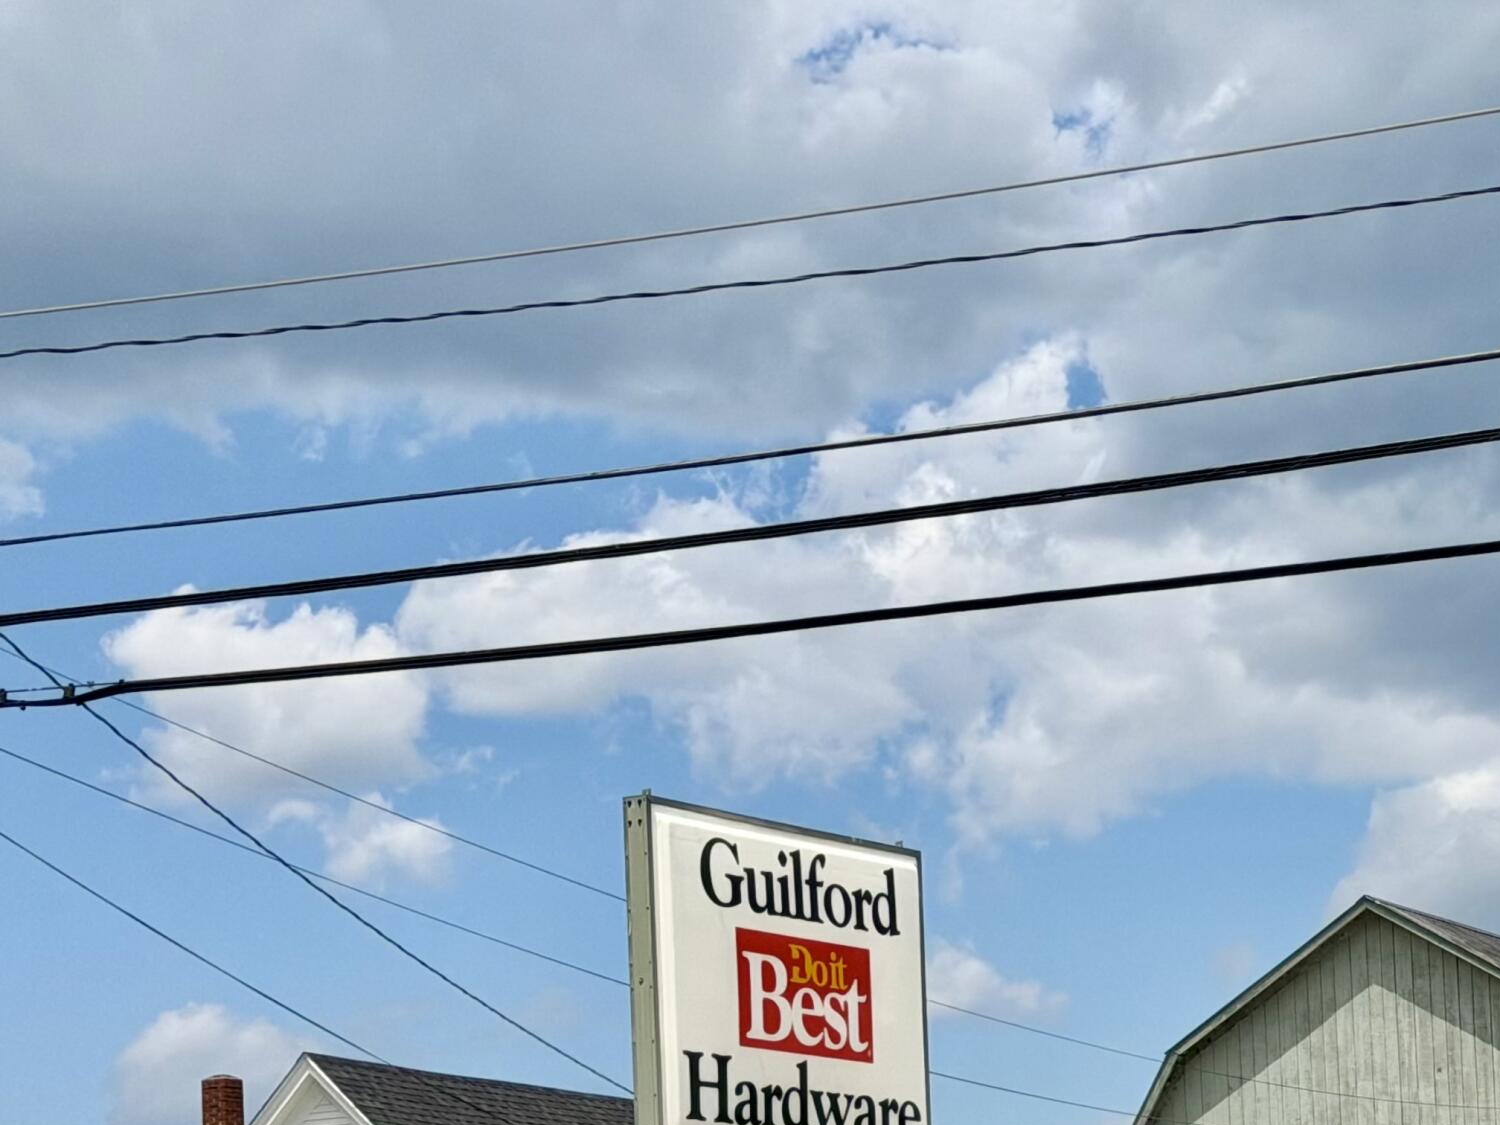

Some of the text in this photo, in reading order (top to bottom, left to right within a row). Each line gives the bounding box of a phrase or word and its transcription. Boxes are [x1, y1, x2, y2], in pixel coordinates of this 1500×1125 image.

[700, 837, 900, 936] Guilford
[742, 950, 869, 1053] Best
[788, 944, 849, 990] Do it
